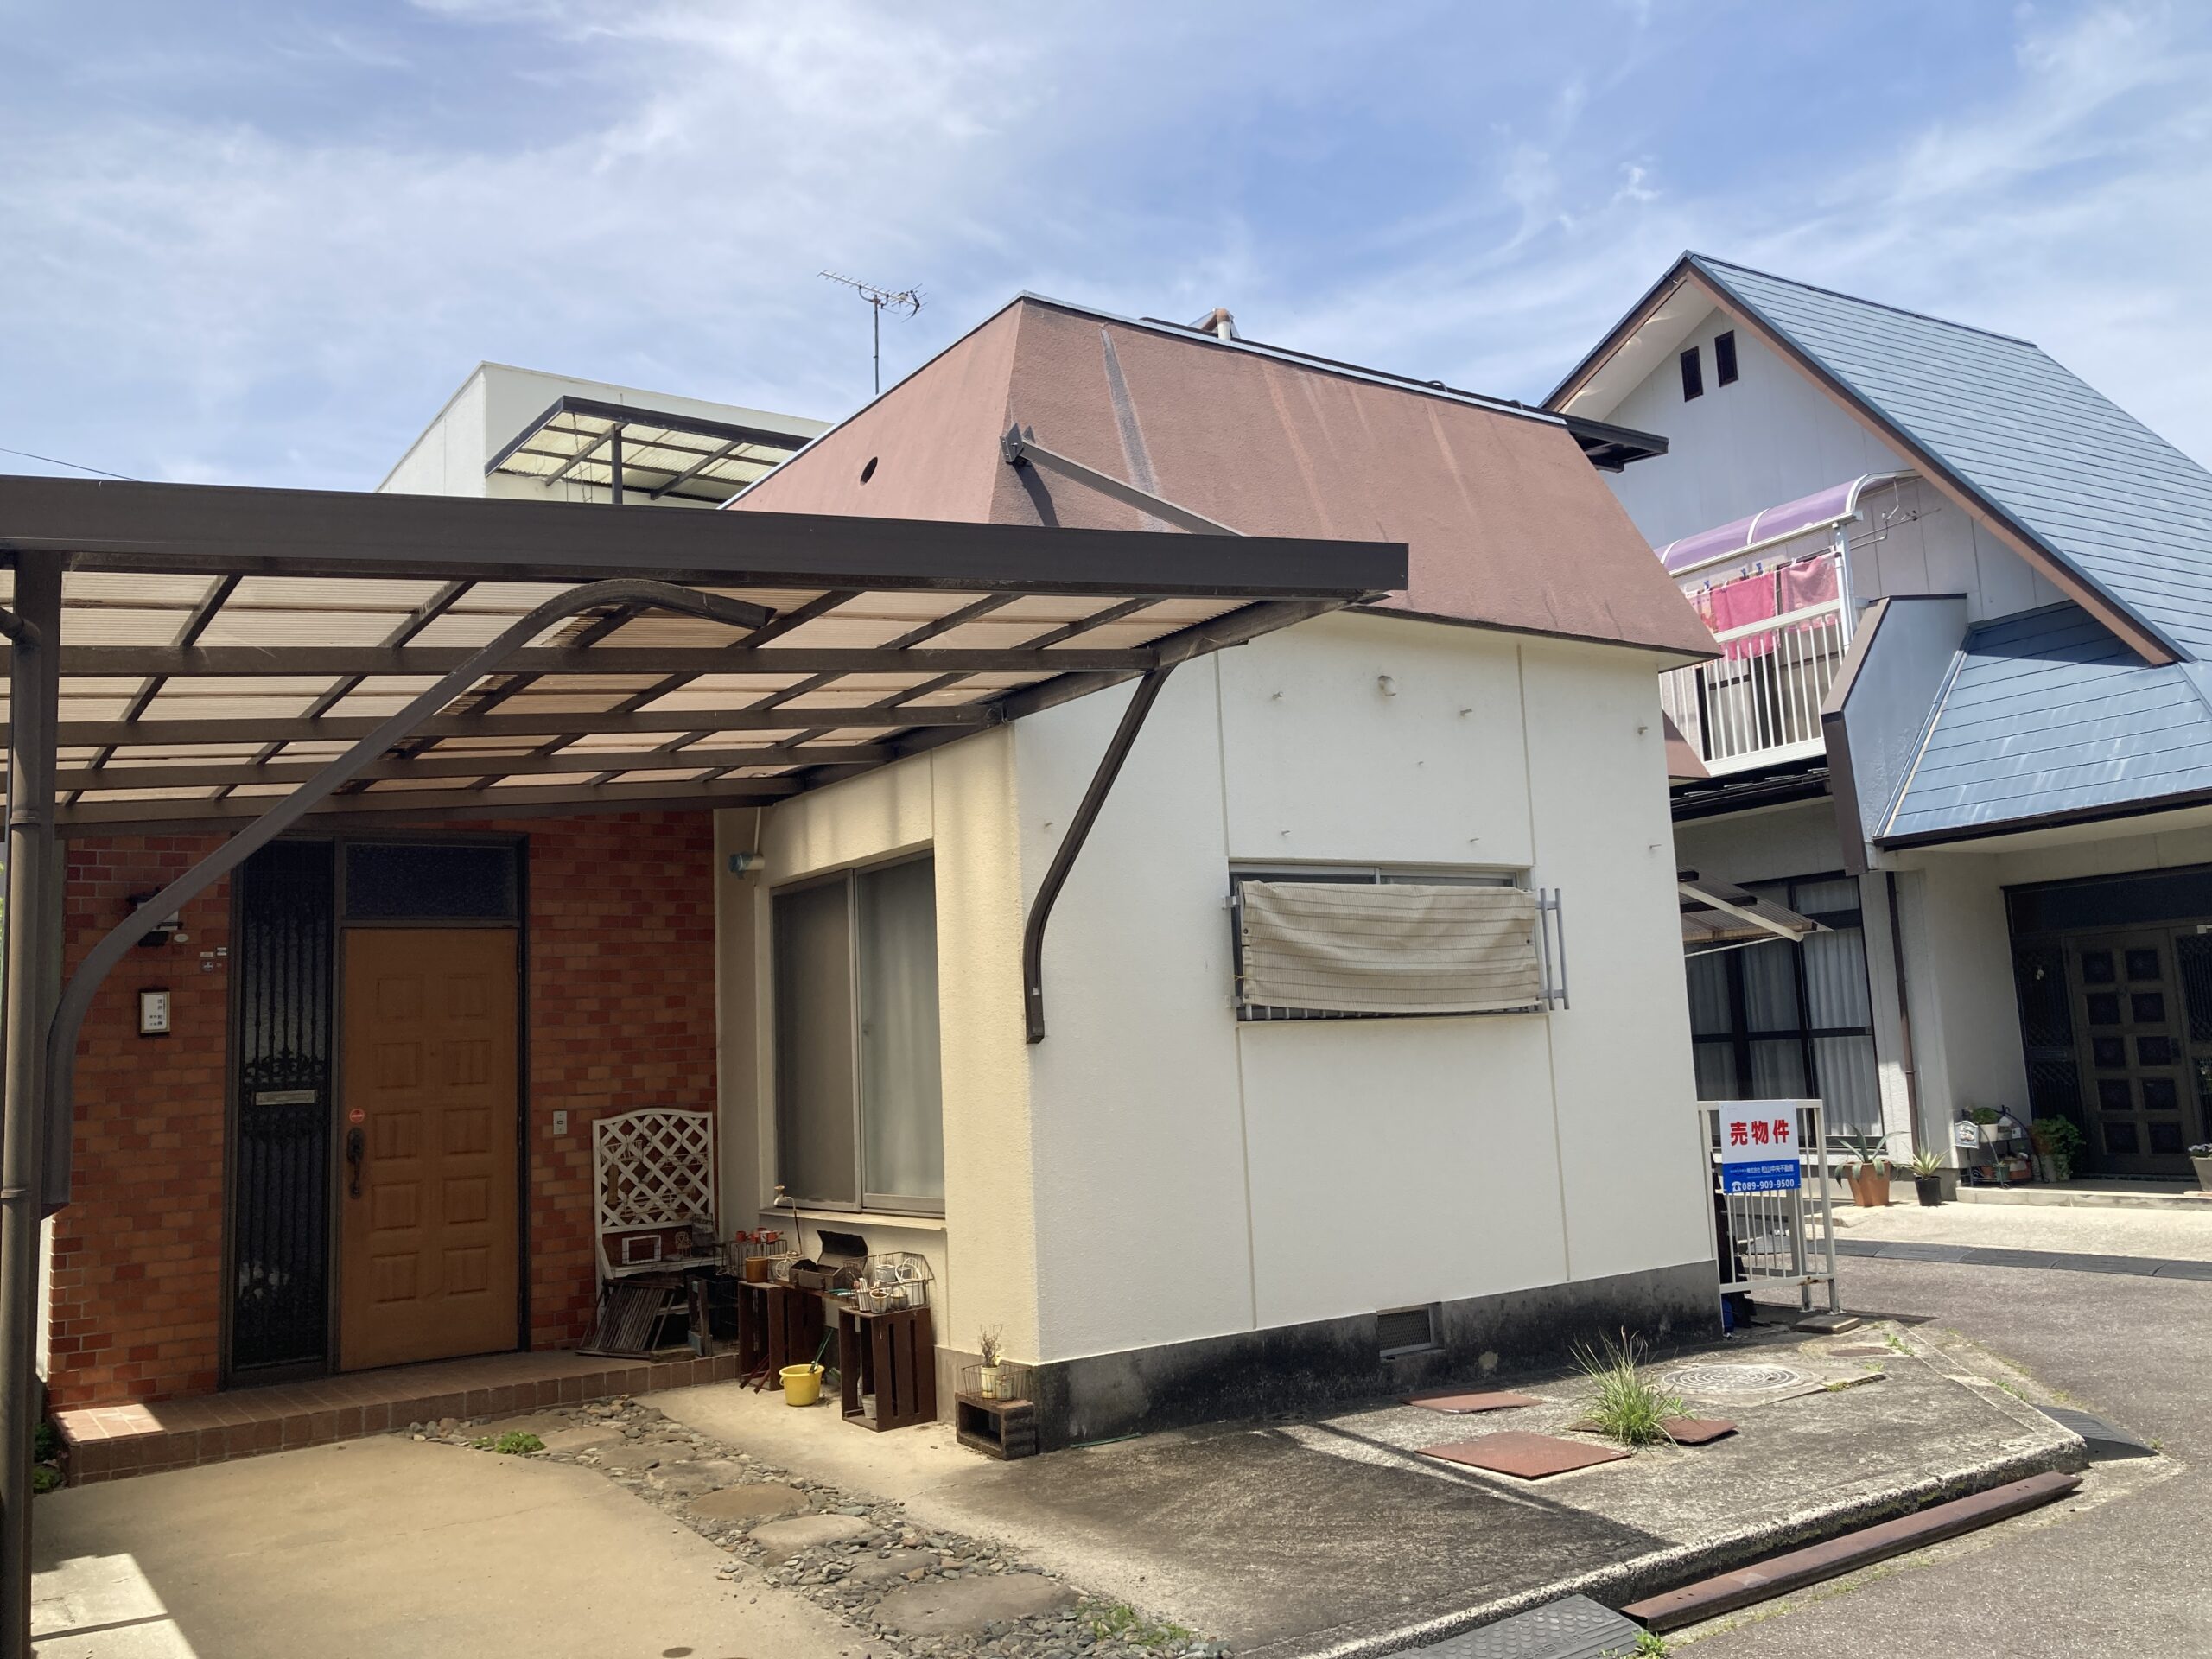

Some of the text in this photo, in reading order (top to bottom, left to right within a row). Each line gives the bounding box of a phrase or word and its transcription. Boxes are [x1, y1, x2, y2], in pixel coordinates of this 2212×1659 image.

[1730, 1120, 1789, 1147] 売物件
[1742, 1179, 1795, 1191] 089-909-9500
